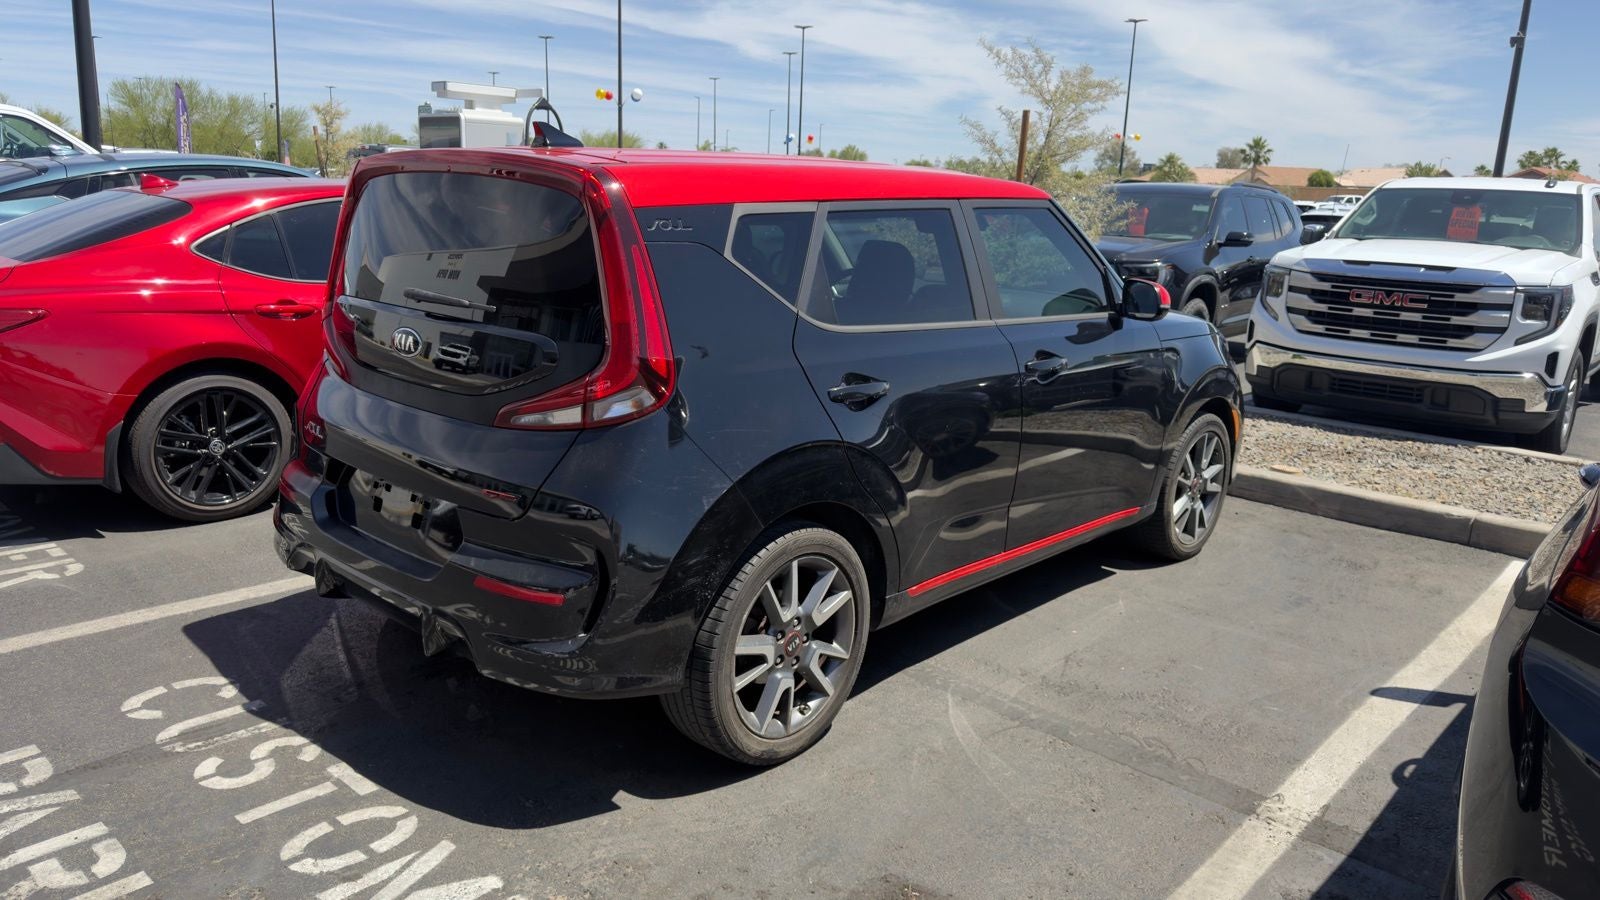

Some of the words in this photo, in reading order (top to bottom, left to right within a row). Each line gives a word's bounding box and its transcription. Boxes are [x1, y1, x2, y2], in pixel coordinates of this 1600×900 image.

[1349, 288, 1430, 309] GMC
[394, 332, 415, 352] KIA
[0, 744, 154, 900] PAR
